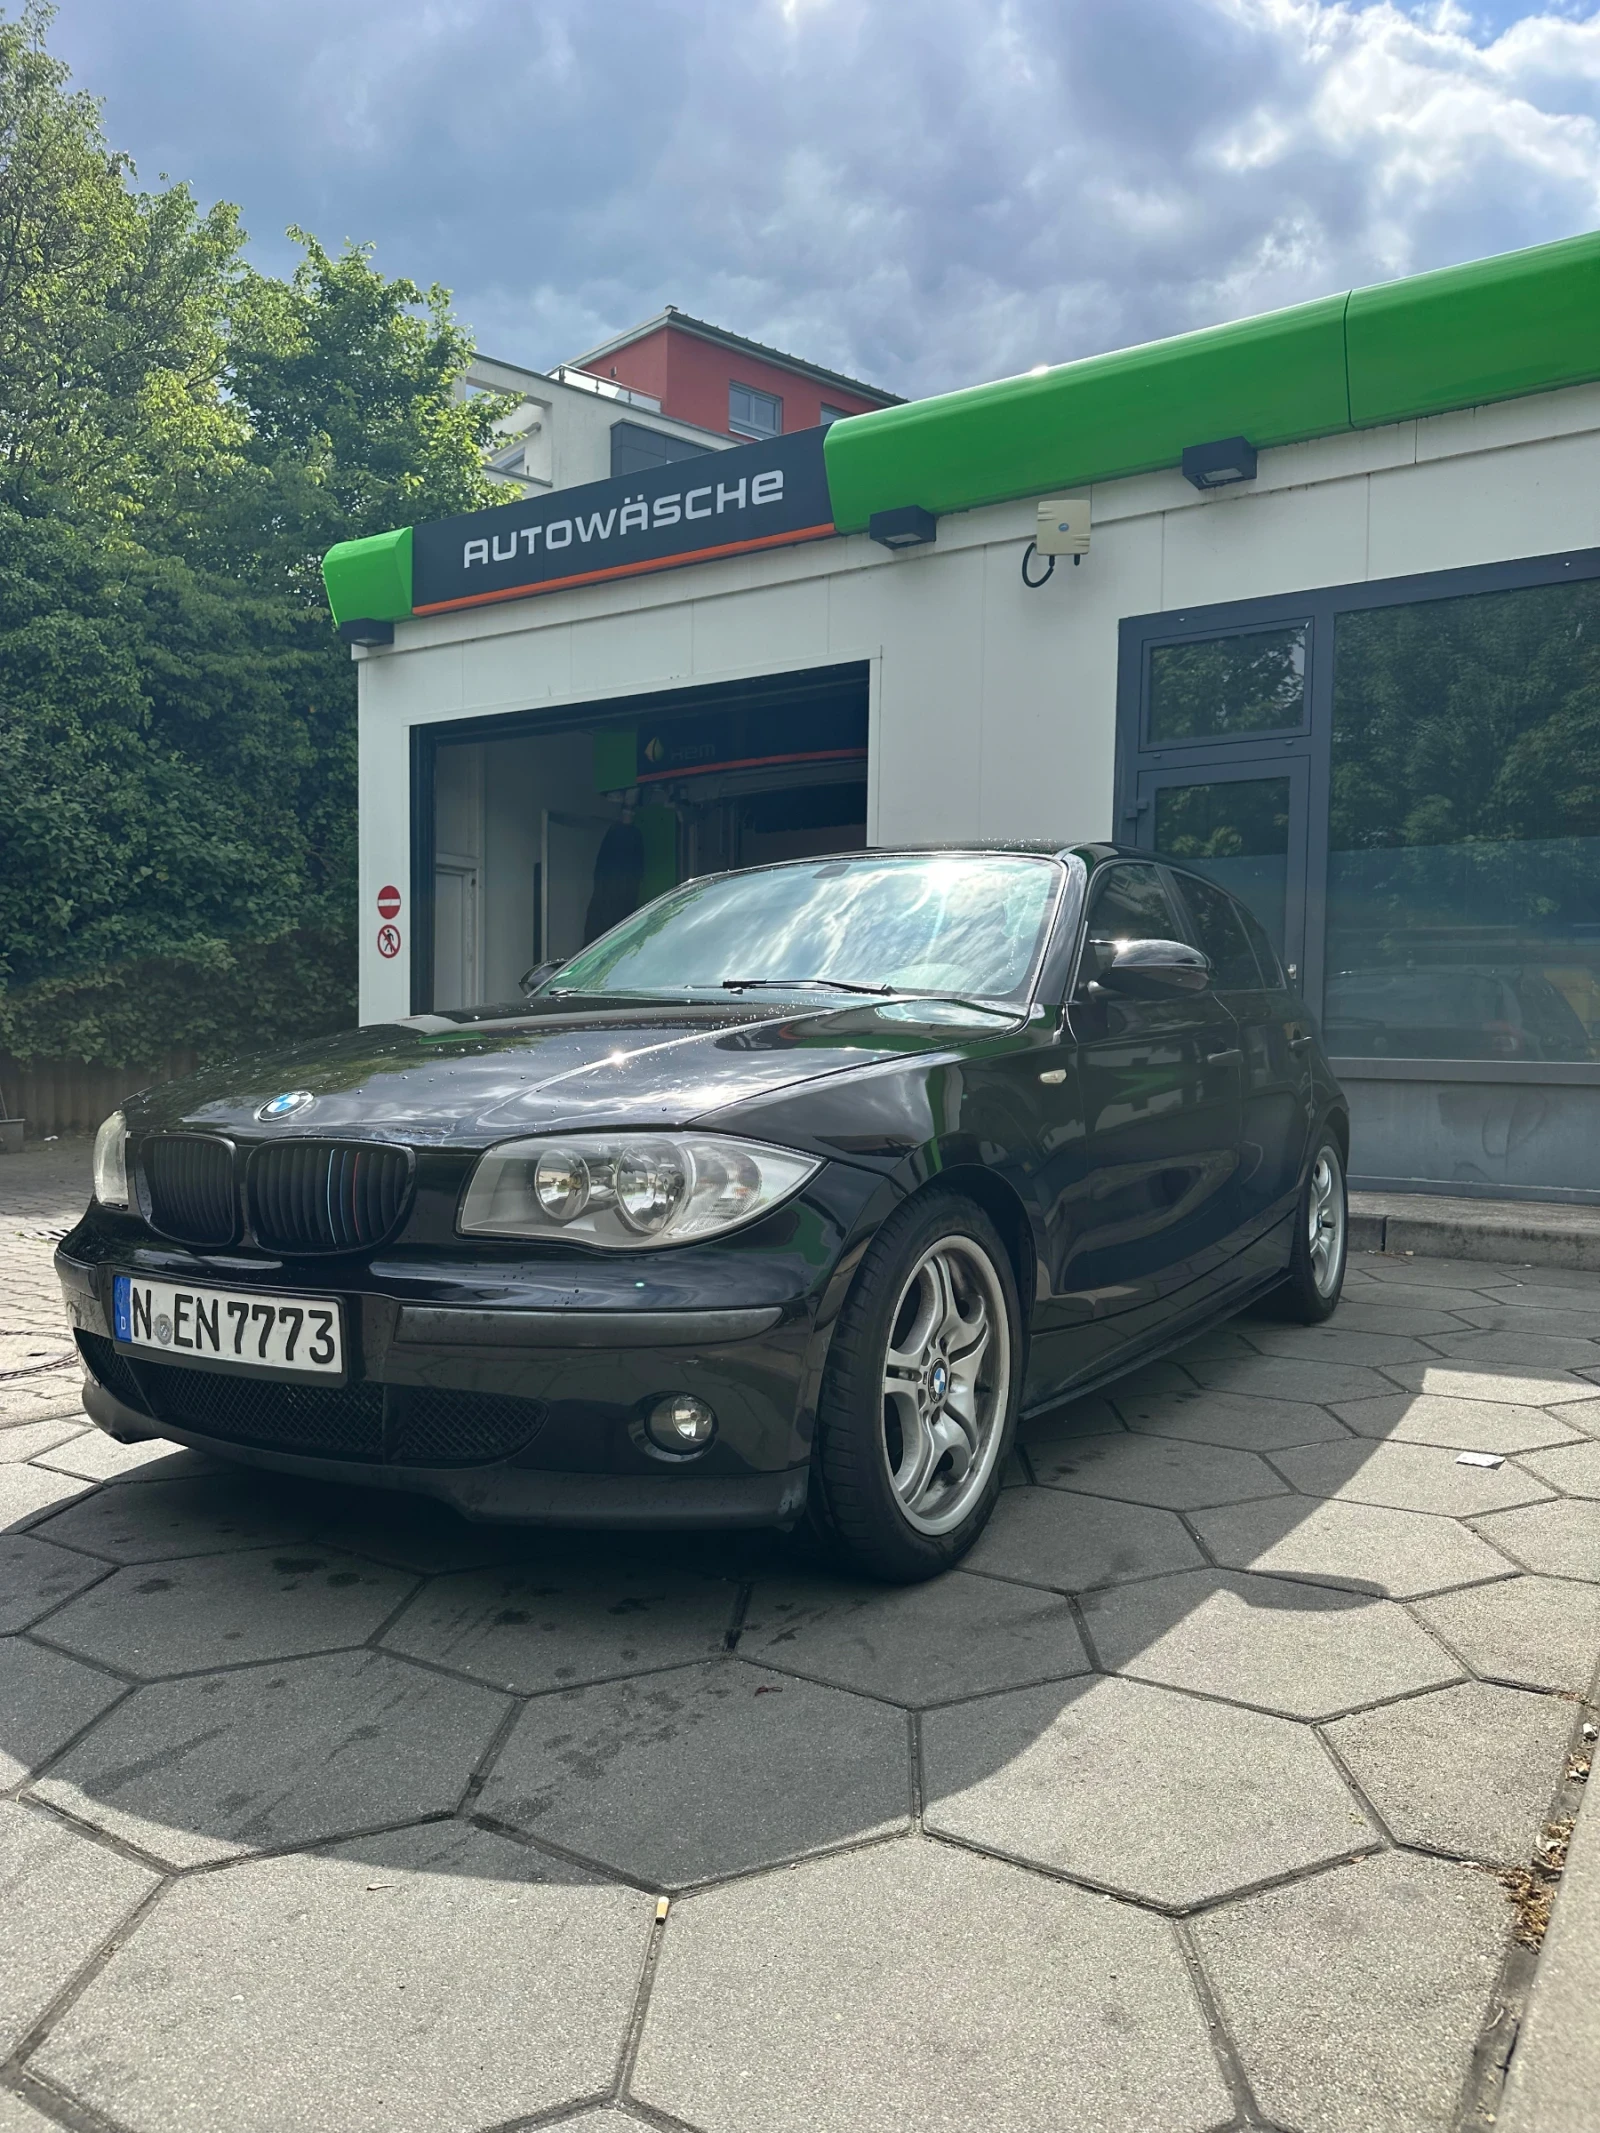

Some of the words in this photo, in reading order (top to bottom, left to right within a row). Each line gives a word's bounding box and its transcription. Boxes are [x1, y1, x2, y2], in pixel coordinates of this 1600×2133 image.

[463, 469, 784, 569] AUTOWÄSCHE
[120, 1316, 127, 1330] D
[132, 1287, 152, 1340] N
